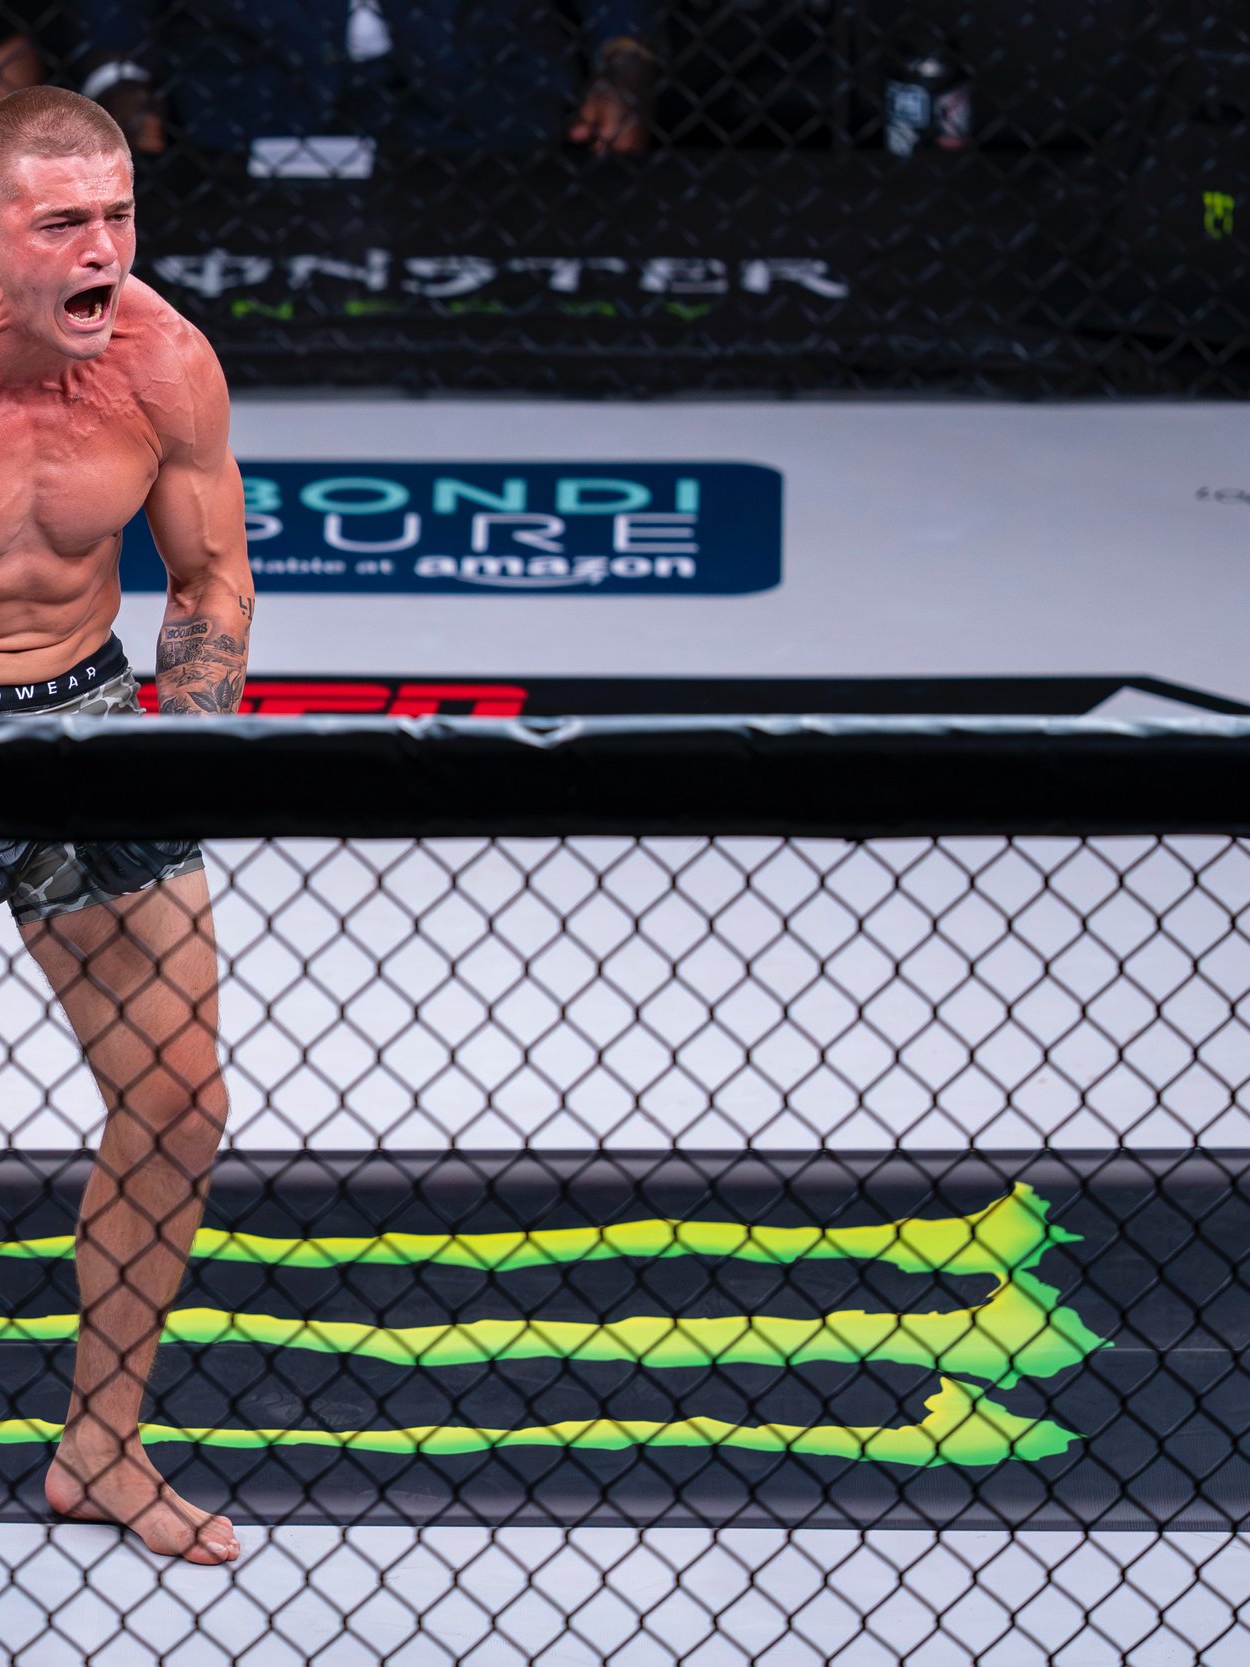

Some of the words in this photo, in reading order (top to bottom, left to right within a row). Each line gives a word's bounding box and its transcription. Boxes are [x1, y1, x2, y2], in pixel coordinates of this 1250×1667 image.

[152, 248, 848, 298] ONSTER
[354, 558, 395, 576] at
[413, 554, 697, 580] amazon
